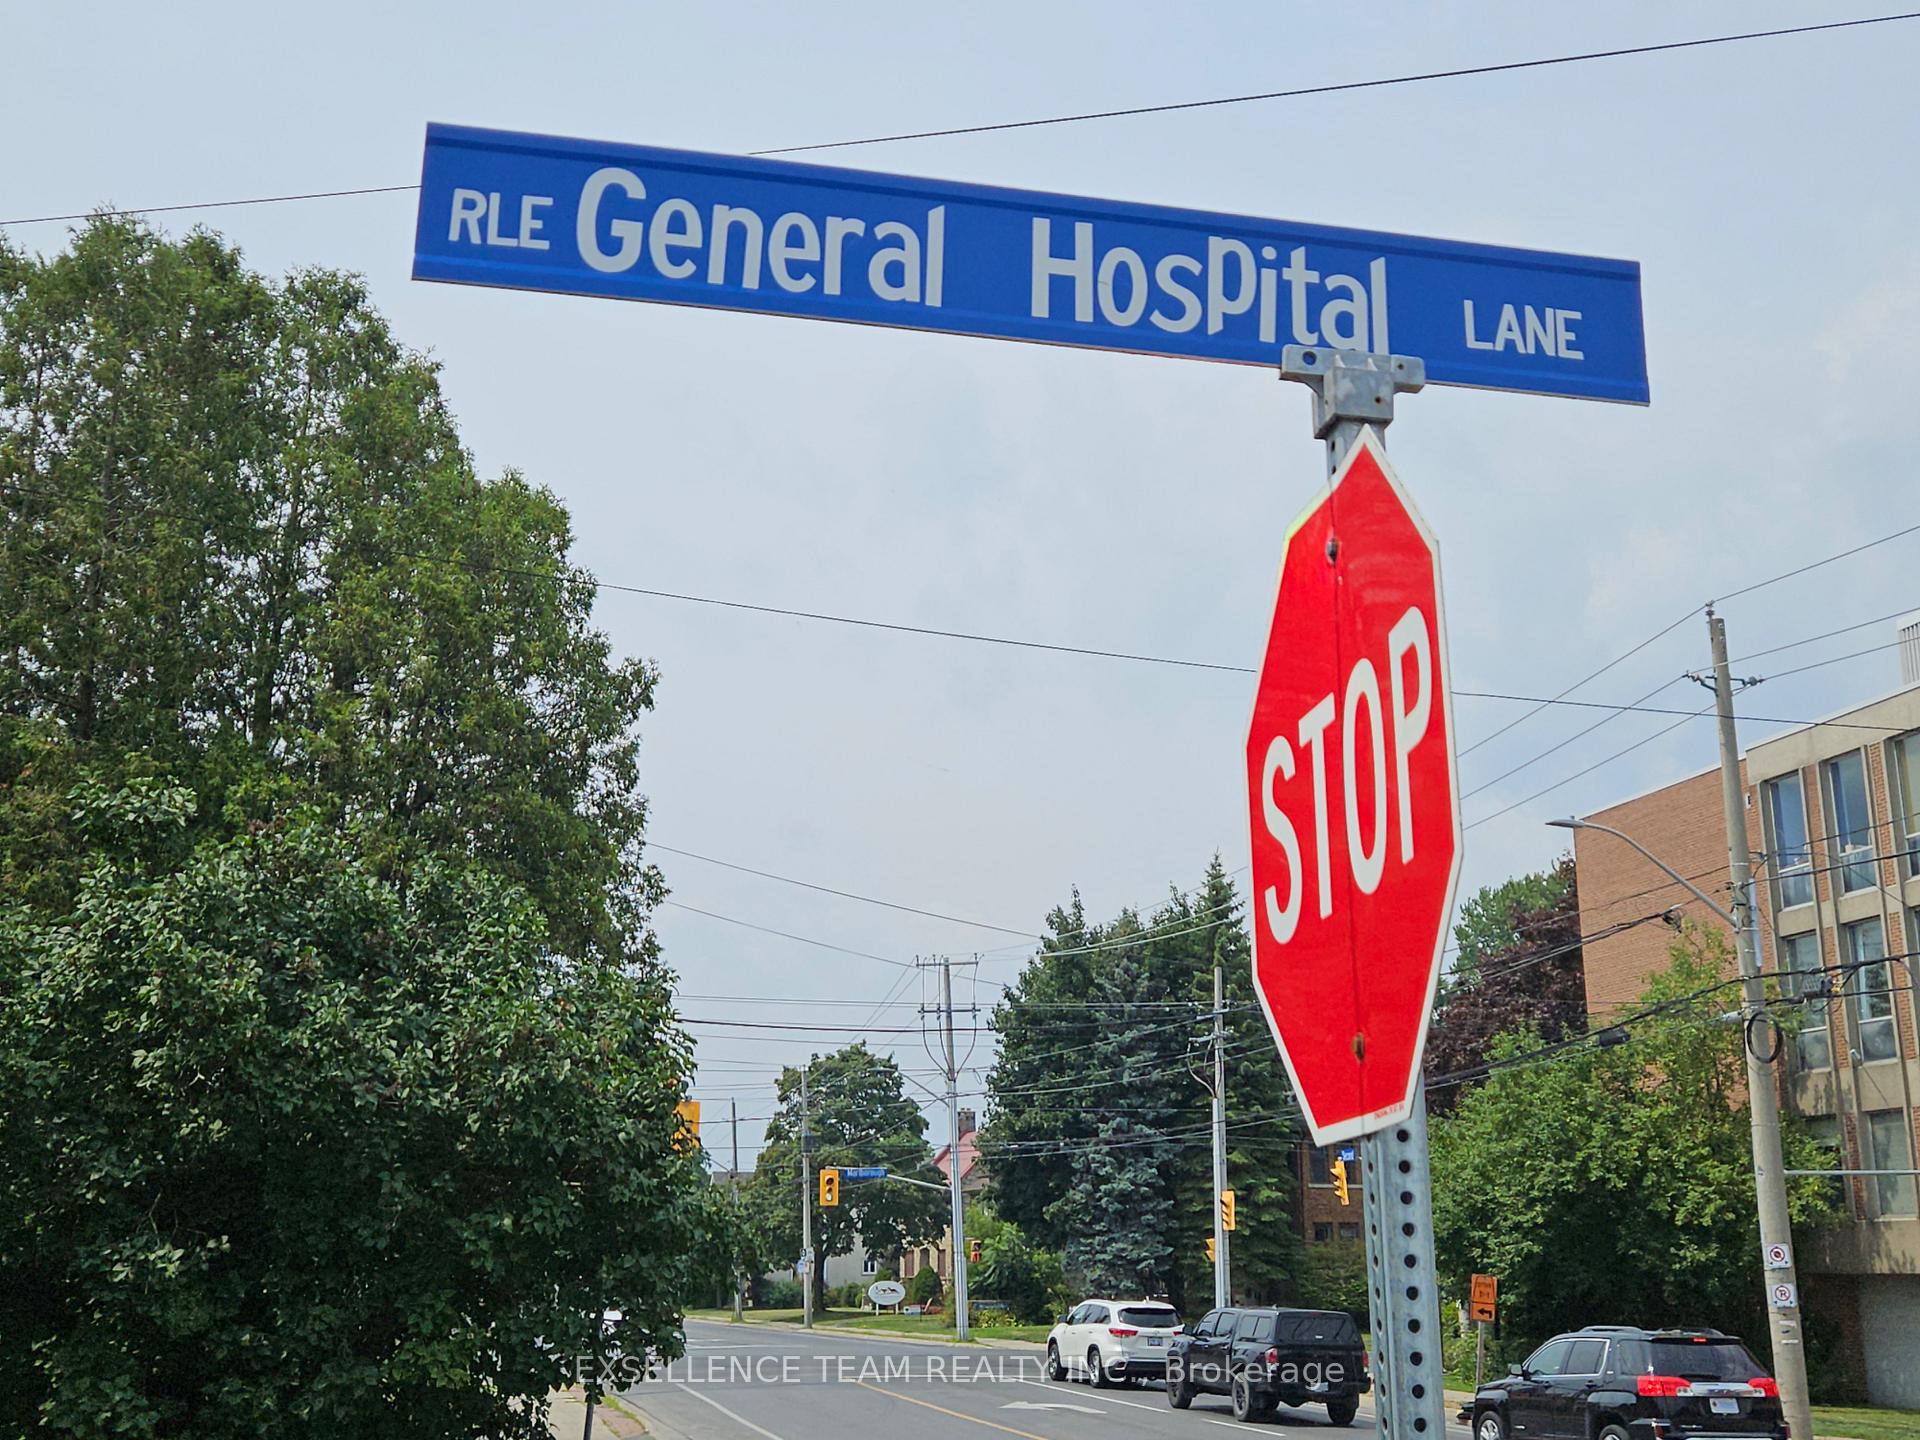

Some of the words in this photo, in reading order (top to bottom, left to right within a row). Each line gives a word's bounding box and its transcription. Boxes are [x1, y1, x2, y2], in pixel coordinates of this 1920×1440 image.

[448, 188, 553, 250] RLE
[576, 167, 945, 307] General
[1031, 217, 1389, 354] Hospital
[1464, 299, 1584, 360] LANE
[1261, 606, 1432, 945] STOP
